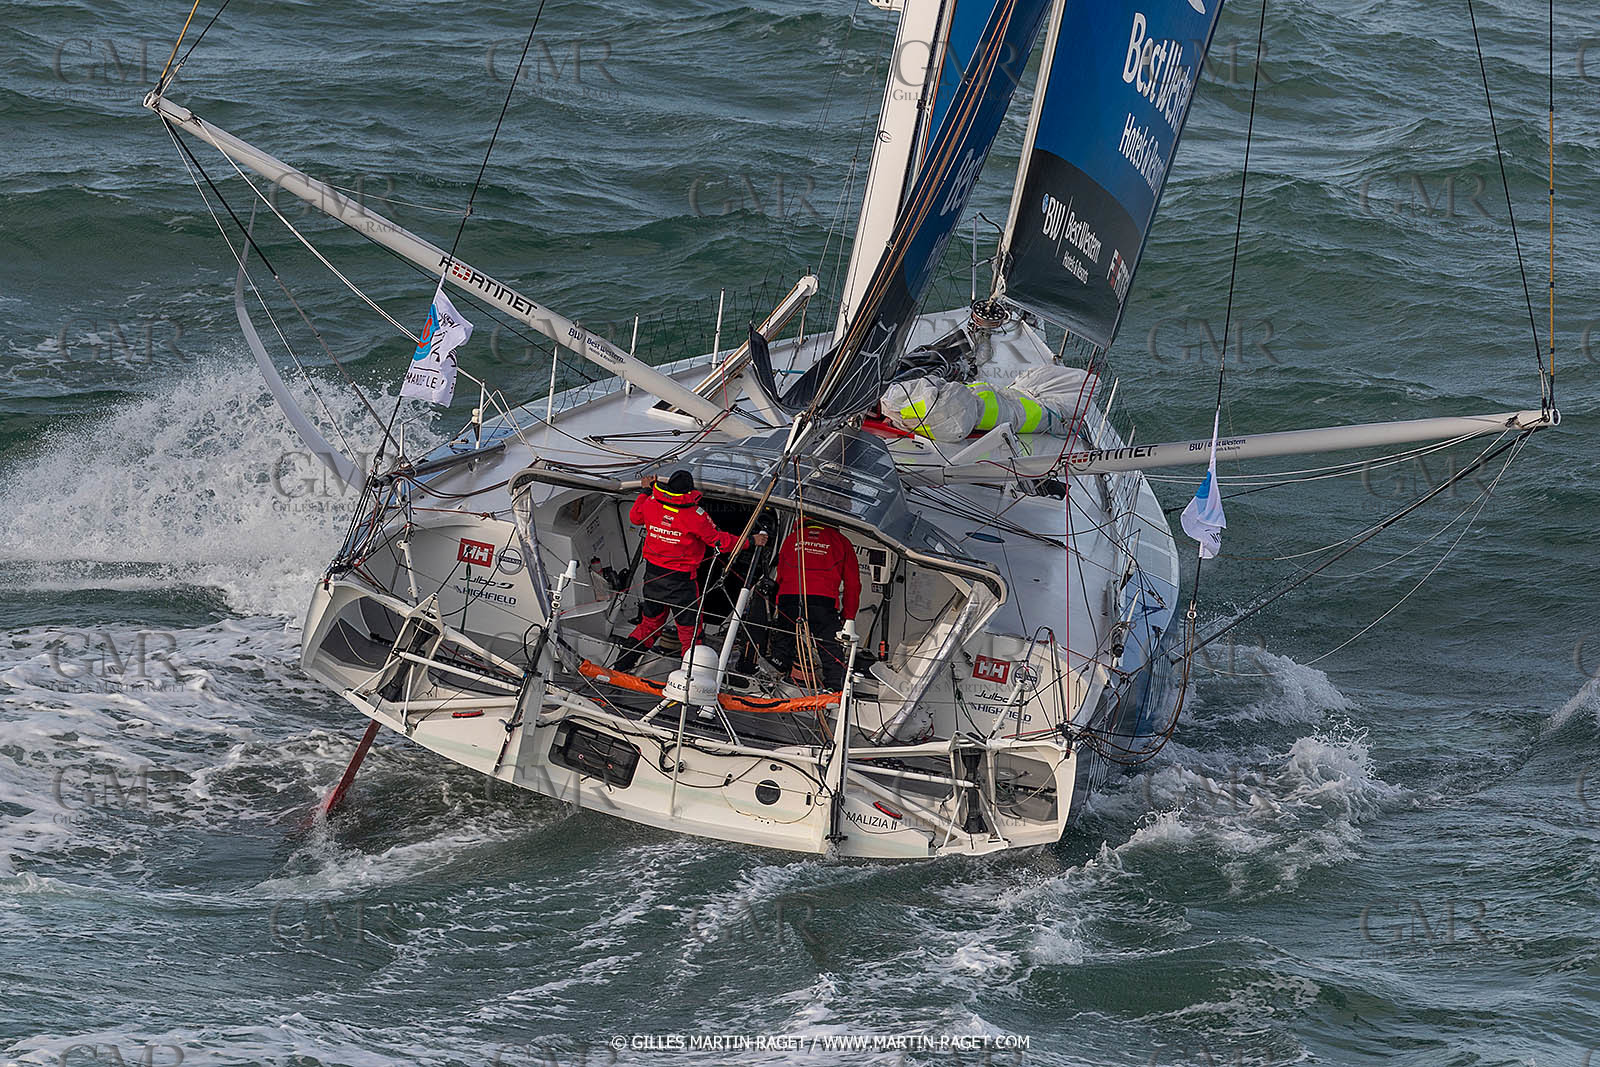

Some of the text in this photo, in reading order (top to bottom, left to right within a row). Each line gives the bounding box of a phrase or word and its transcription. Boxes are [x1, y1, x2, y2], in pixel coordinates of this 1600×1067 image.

[1122, 12, 1167, 104] Best
[1119, 112, 1149, 170] Hotels
[1043, 197, 1066, 240] BW
[438, 255, 538, 316] FORTINET
[1058, 445, 1158, 466] FORTINET
[649, 525, 682, 536] FORTINET
[845, 811, 888, 829] MALIZIA
